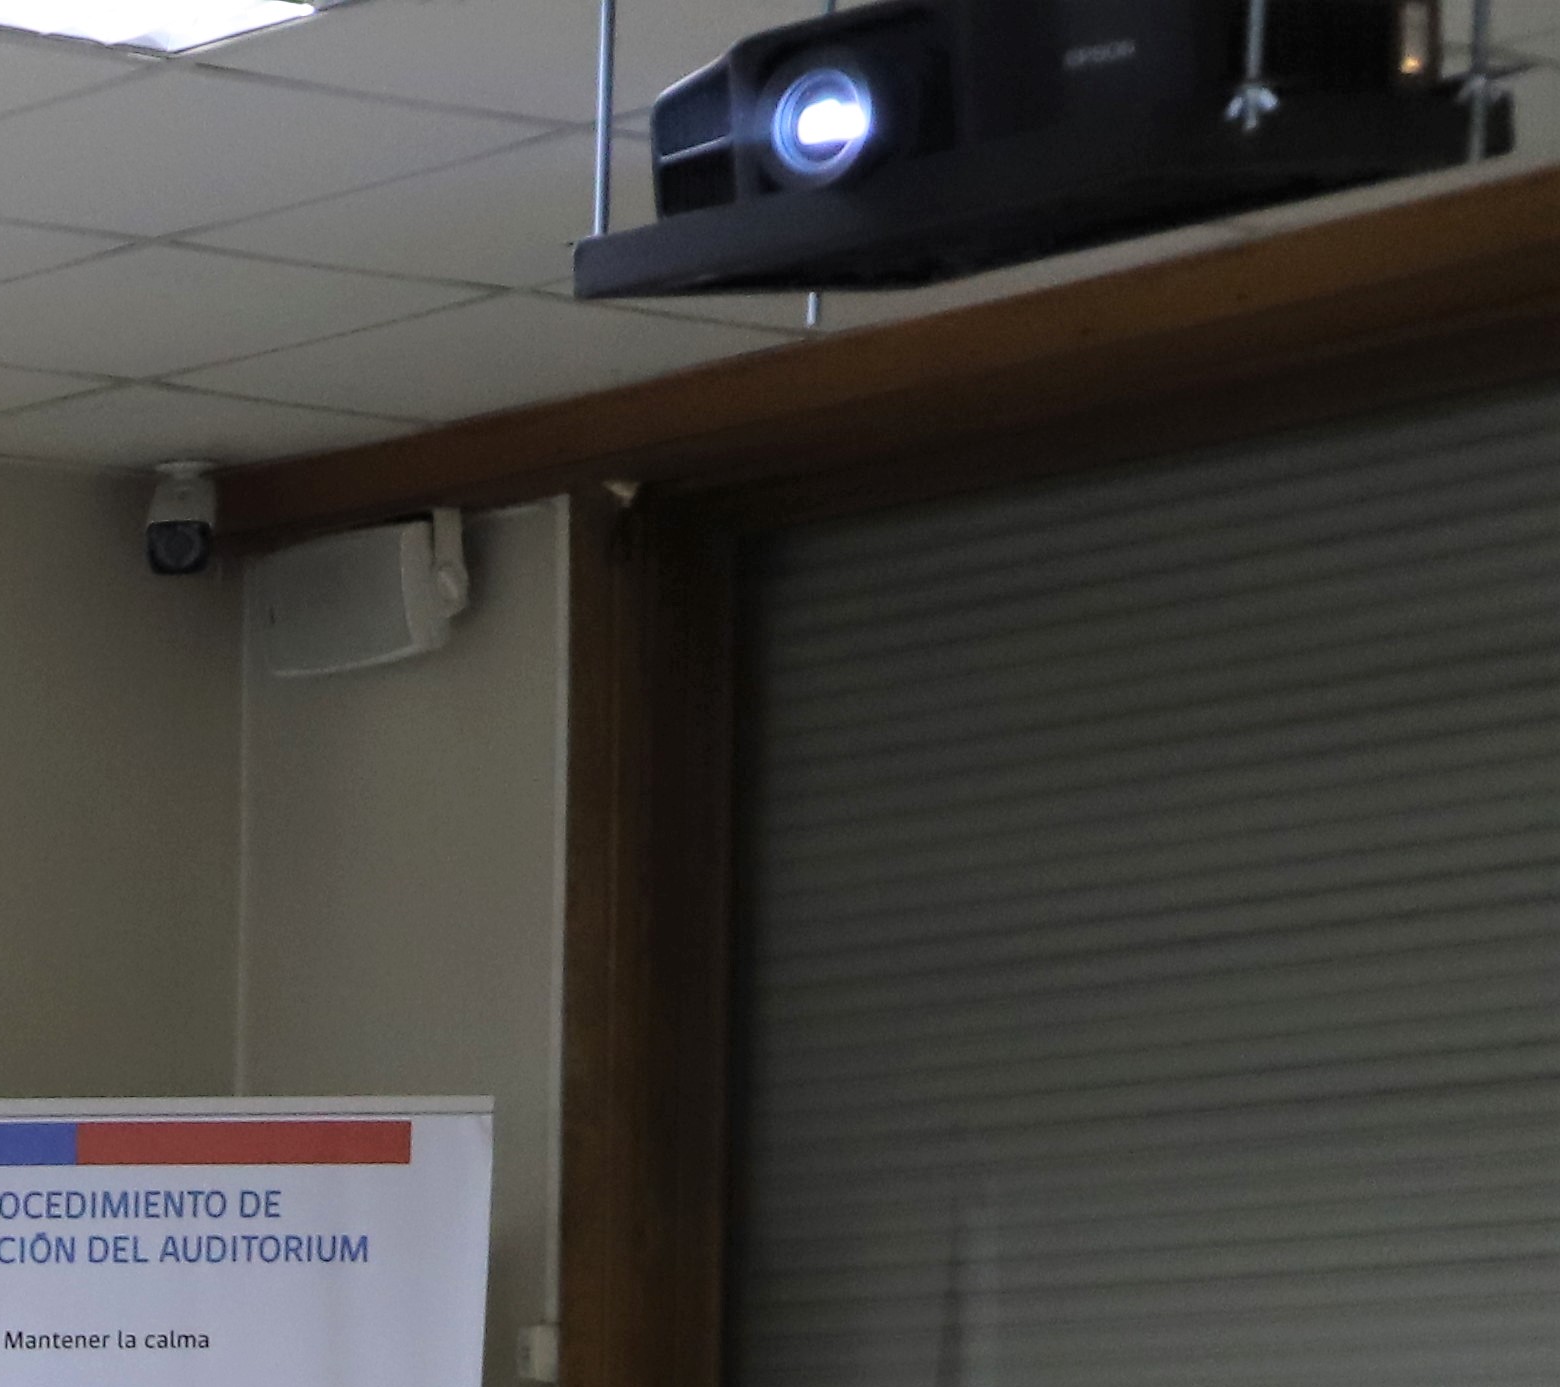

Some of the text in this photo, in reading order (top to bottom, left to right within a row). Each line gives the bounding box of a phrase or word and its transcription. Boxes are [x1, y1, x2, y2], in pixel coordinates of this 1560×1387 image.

[239, 1189, 282, 1219] DE
[87, 1235, 150, 1264] DEL
[159, 1234, 369, 1265] AUDITORIUM
[4, 1329, 210, 1350] Mantener la calma
